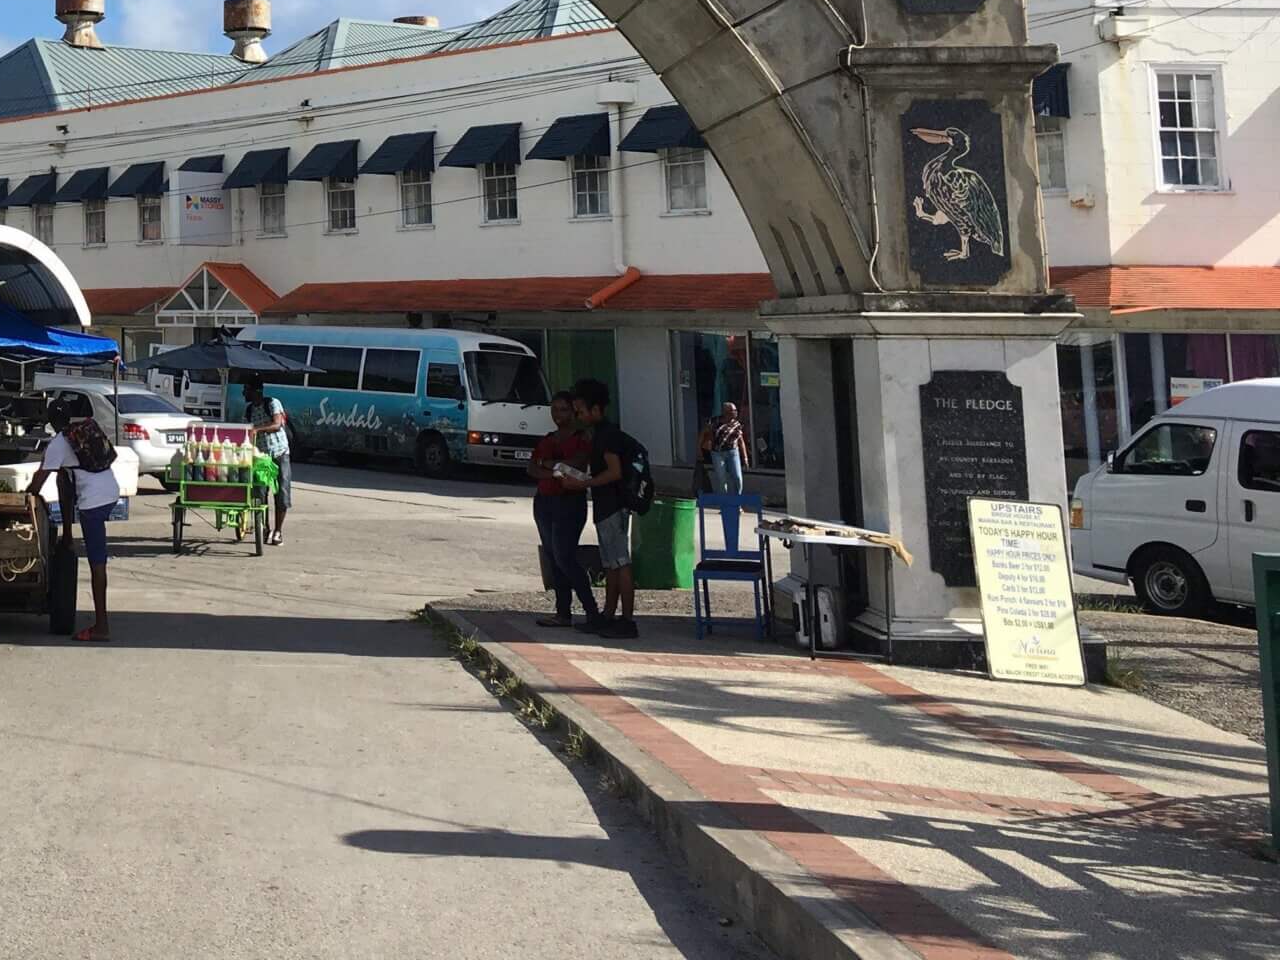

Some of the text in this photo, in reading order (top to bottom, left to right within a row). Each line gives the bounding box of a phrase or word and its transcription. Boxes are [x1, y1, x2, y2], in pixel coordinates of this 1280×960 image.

[934, 397, 1013, 411] THE PLEDGE
[316, 396, 383, 430] Sandals
[991, 503, 1043, 515] UPSTAIRS
[979, 526, 1058, 541] TODAY'S HAPPY HOUR
